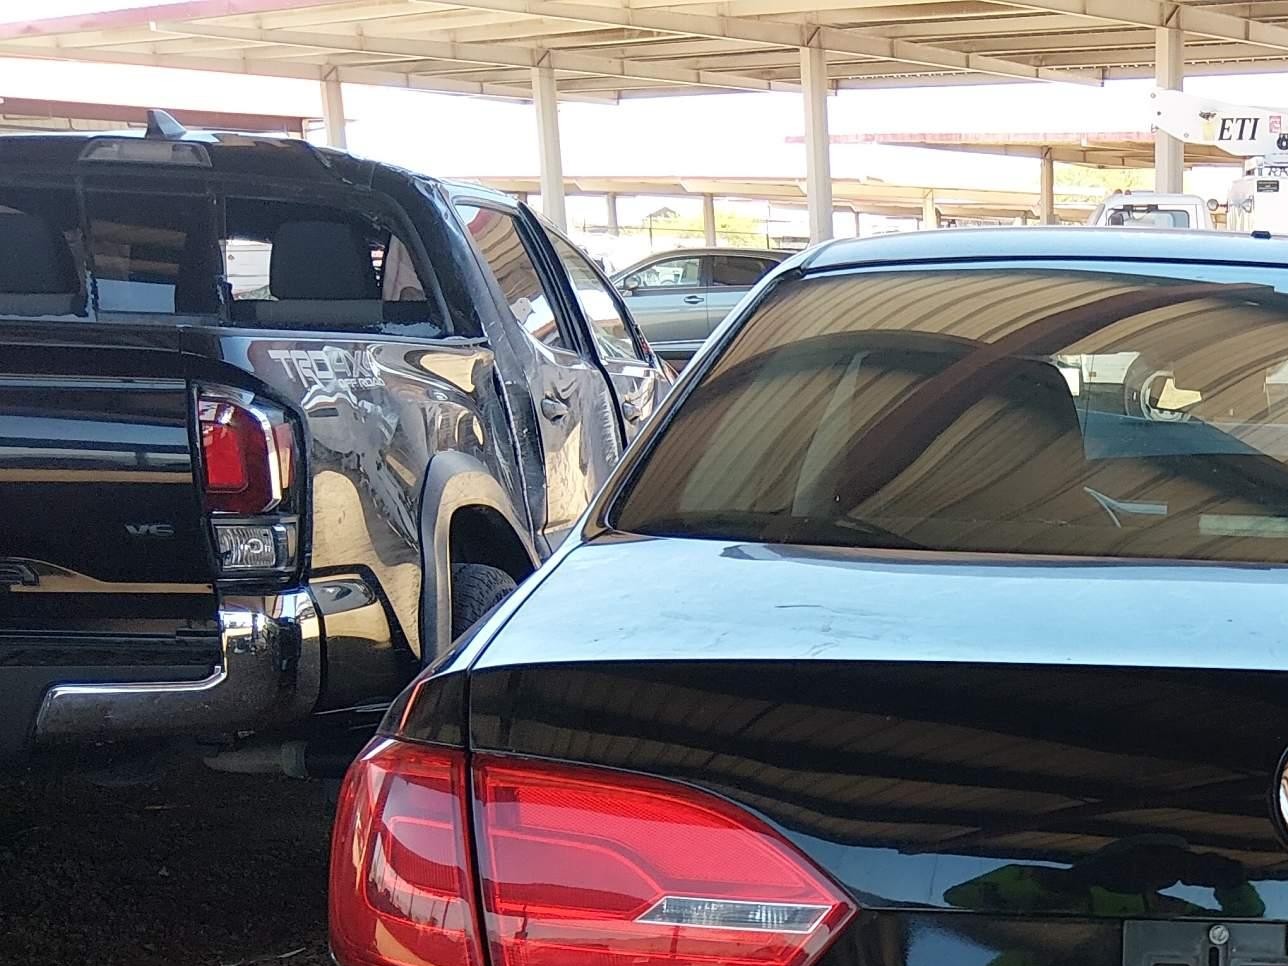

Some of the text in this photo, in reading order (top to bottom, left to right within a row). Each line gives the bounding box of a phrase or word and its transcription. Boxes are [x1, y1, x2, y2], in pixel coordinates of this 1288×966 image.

[1218, 117, 1260, 141] ETI
[267, 349, 337, 391] TRD
[124, 524, 175, 537] V6
